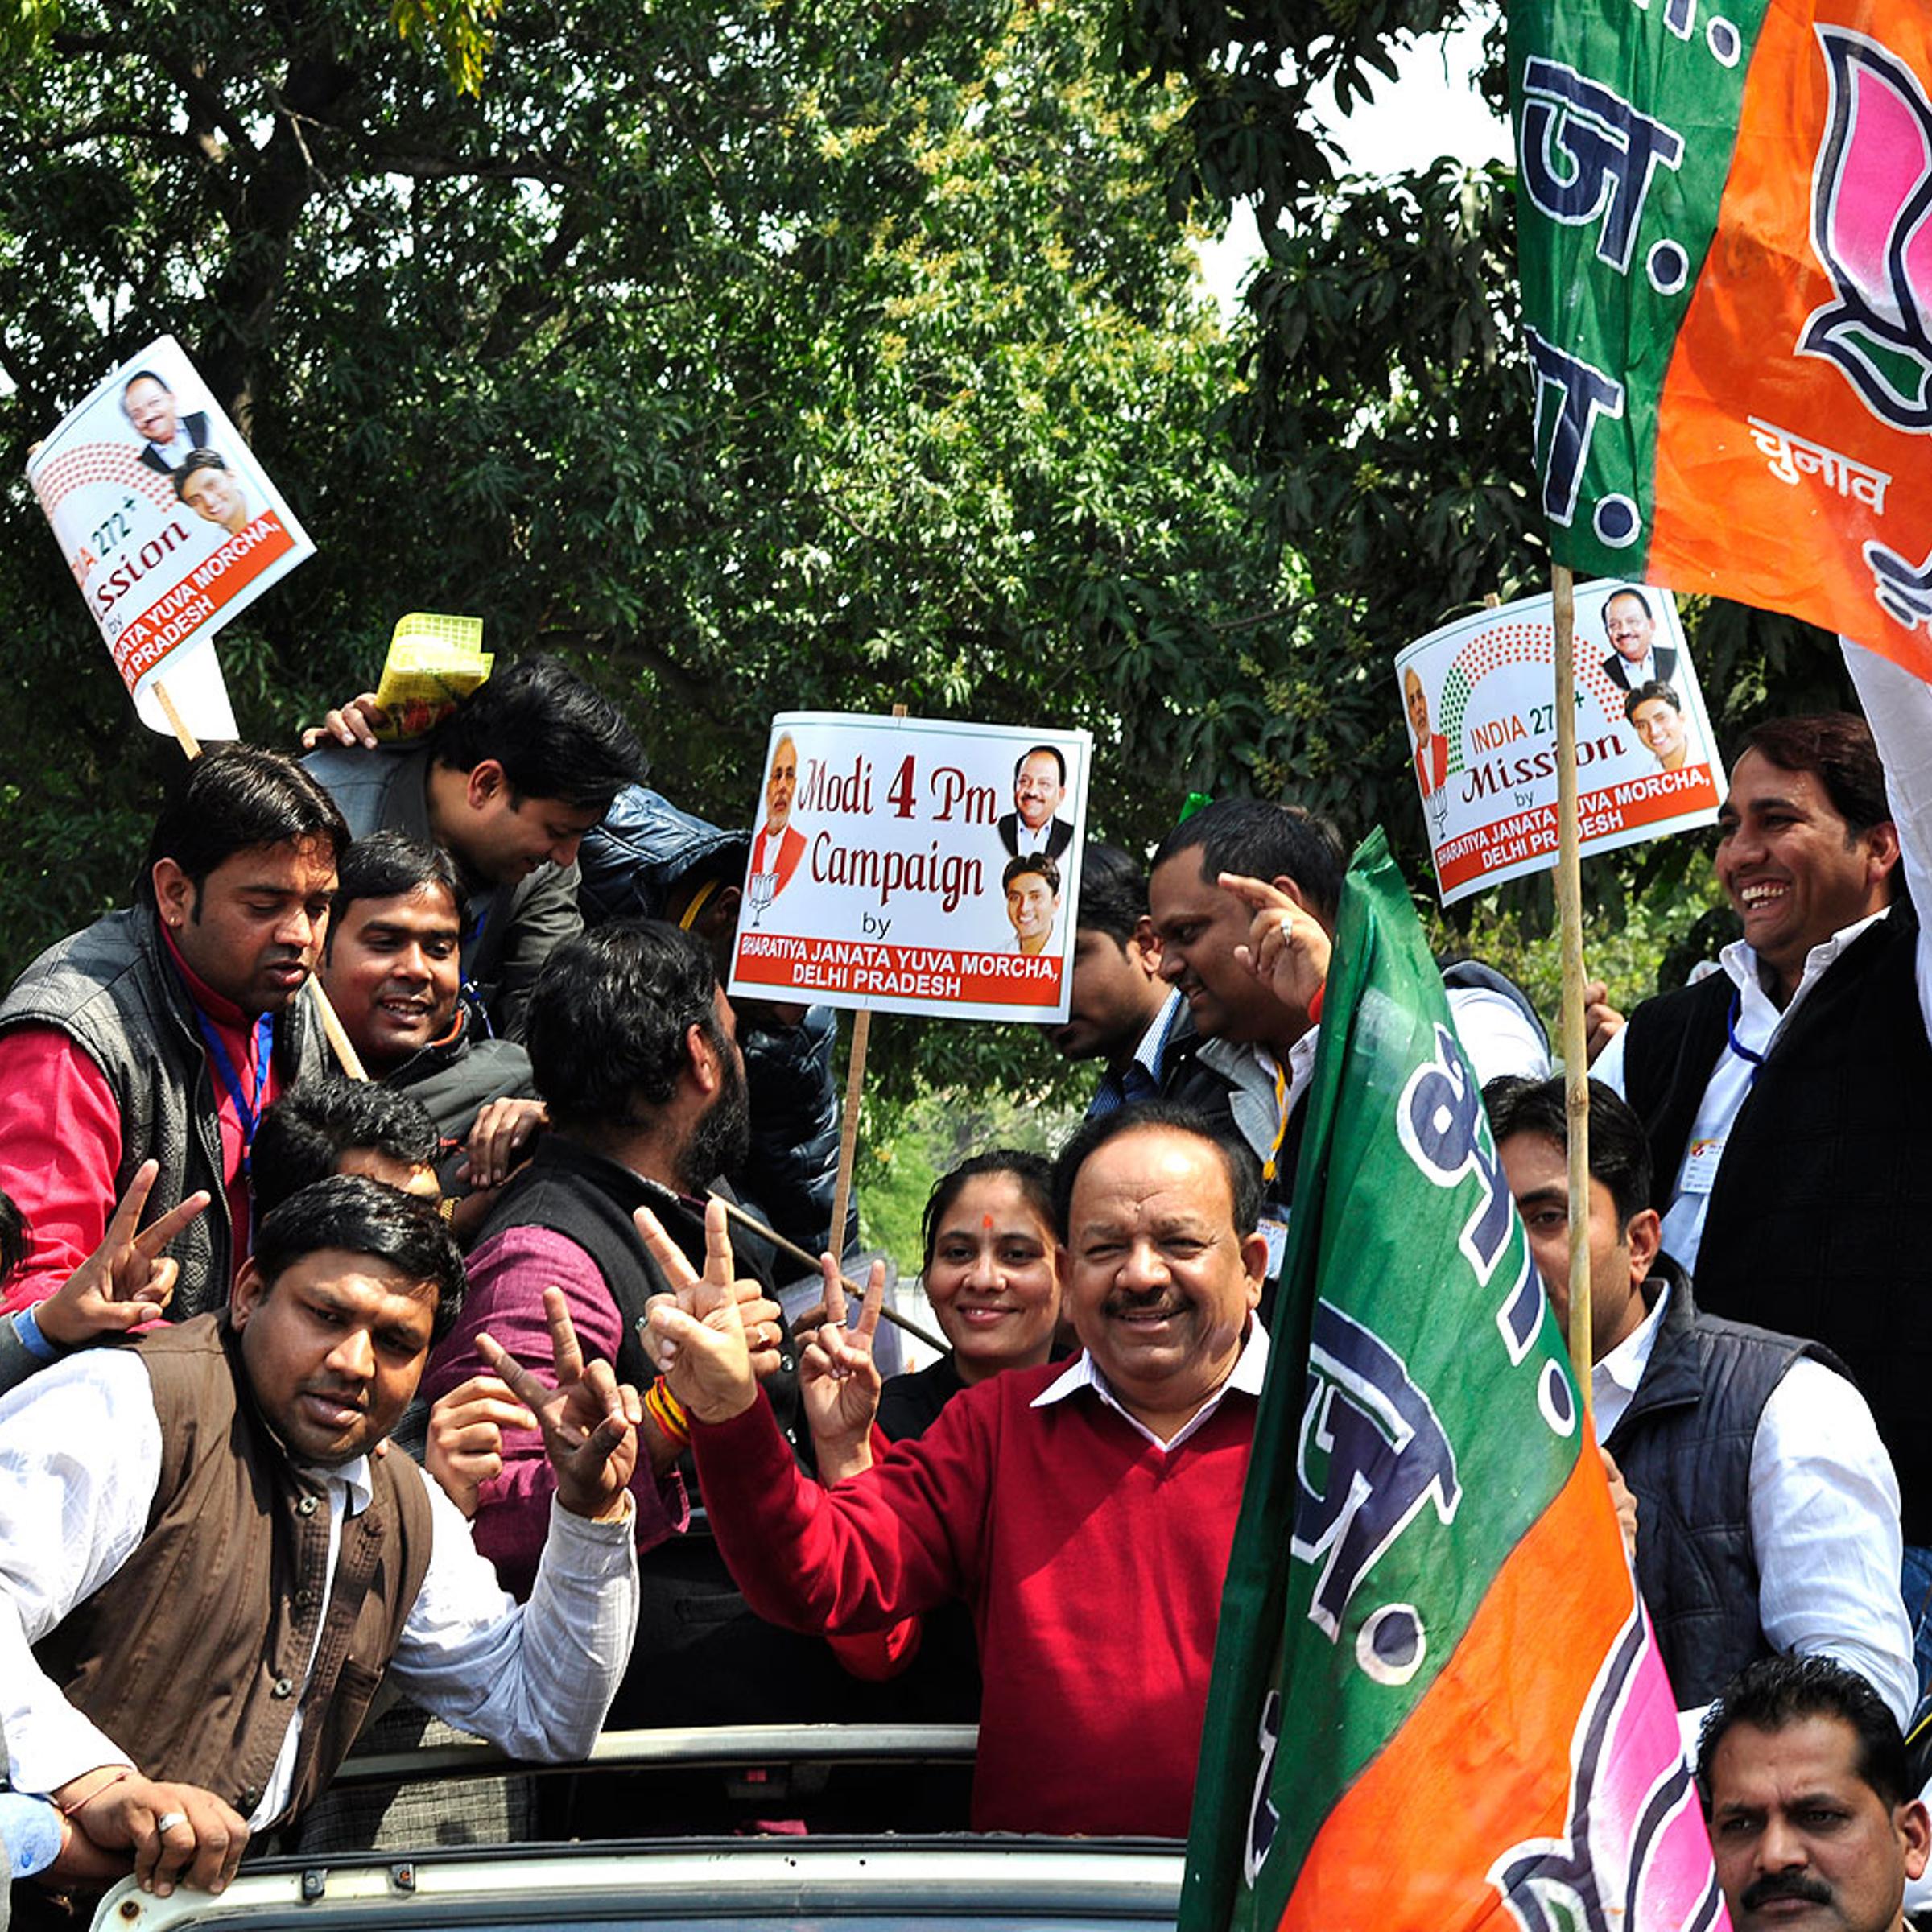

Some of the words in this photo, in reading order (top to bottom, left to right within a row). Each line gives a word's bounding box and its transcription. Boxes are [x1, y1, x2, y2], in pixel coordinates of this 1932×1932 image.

[1747, 415, 1892, 516] चुनाव
[89, 521, 191, 623] ission
[145, 583, 198, 627] YUVA
[130, 593, 216, 672] PRADESH
[1470, 714, 1528, 755] INDIA
[798, 753, 873, 815] Modi
[887, 754, 916, 819] 4
[930, 766, 998, 824] Pm
[1492, 808, 1558, 844] JANATA
[1614, 767, 1711, 806] MORCHA,
[1514, 791, 1534, 808] by
[811, 830, 984, 913] Campaign
[1481, 839, 1529, 869] DELHI
[863, 911, 892, 939] by
[741, 935, 807, 960] BHARATIYA
[811, 942, 891, 968] JANATA
[896, 948, 956, 973] YUVA
[960, 955, 1059, 983] MORCHA,
[792, 963, 848, 988] DELHI
[853, 969, 962, 997] PRADESH
